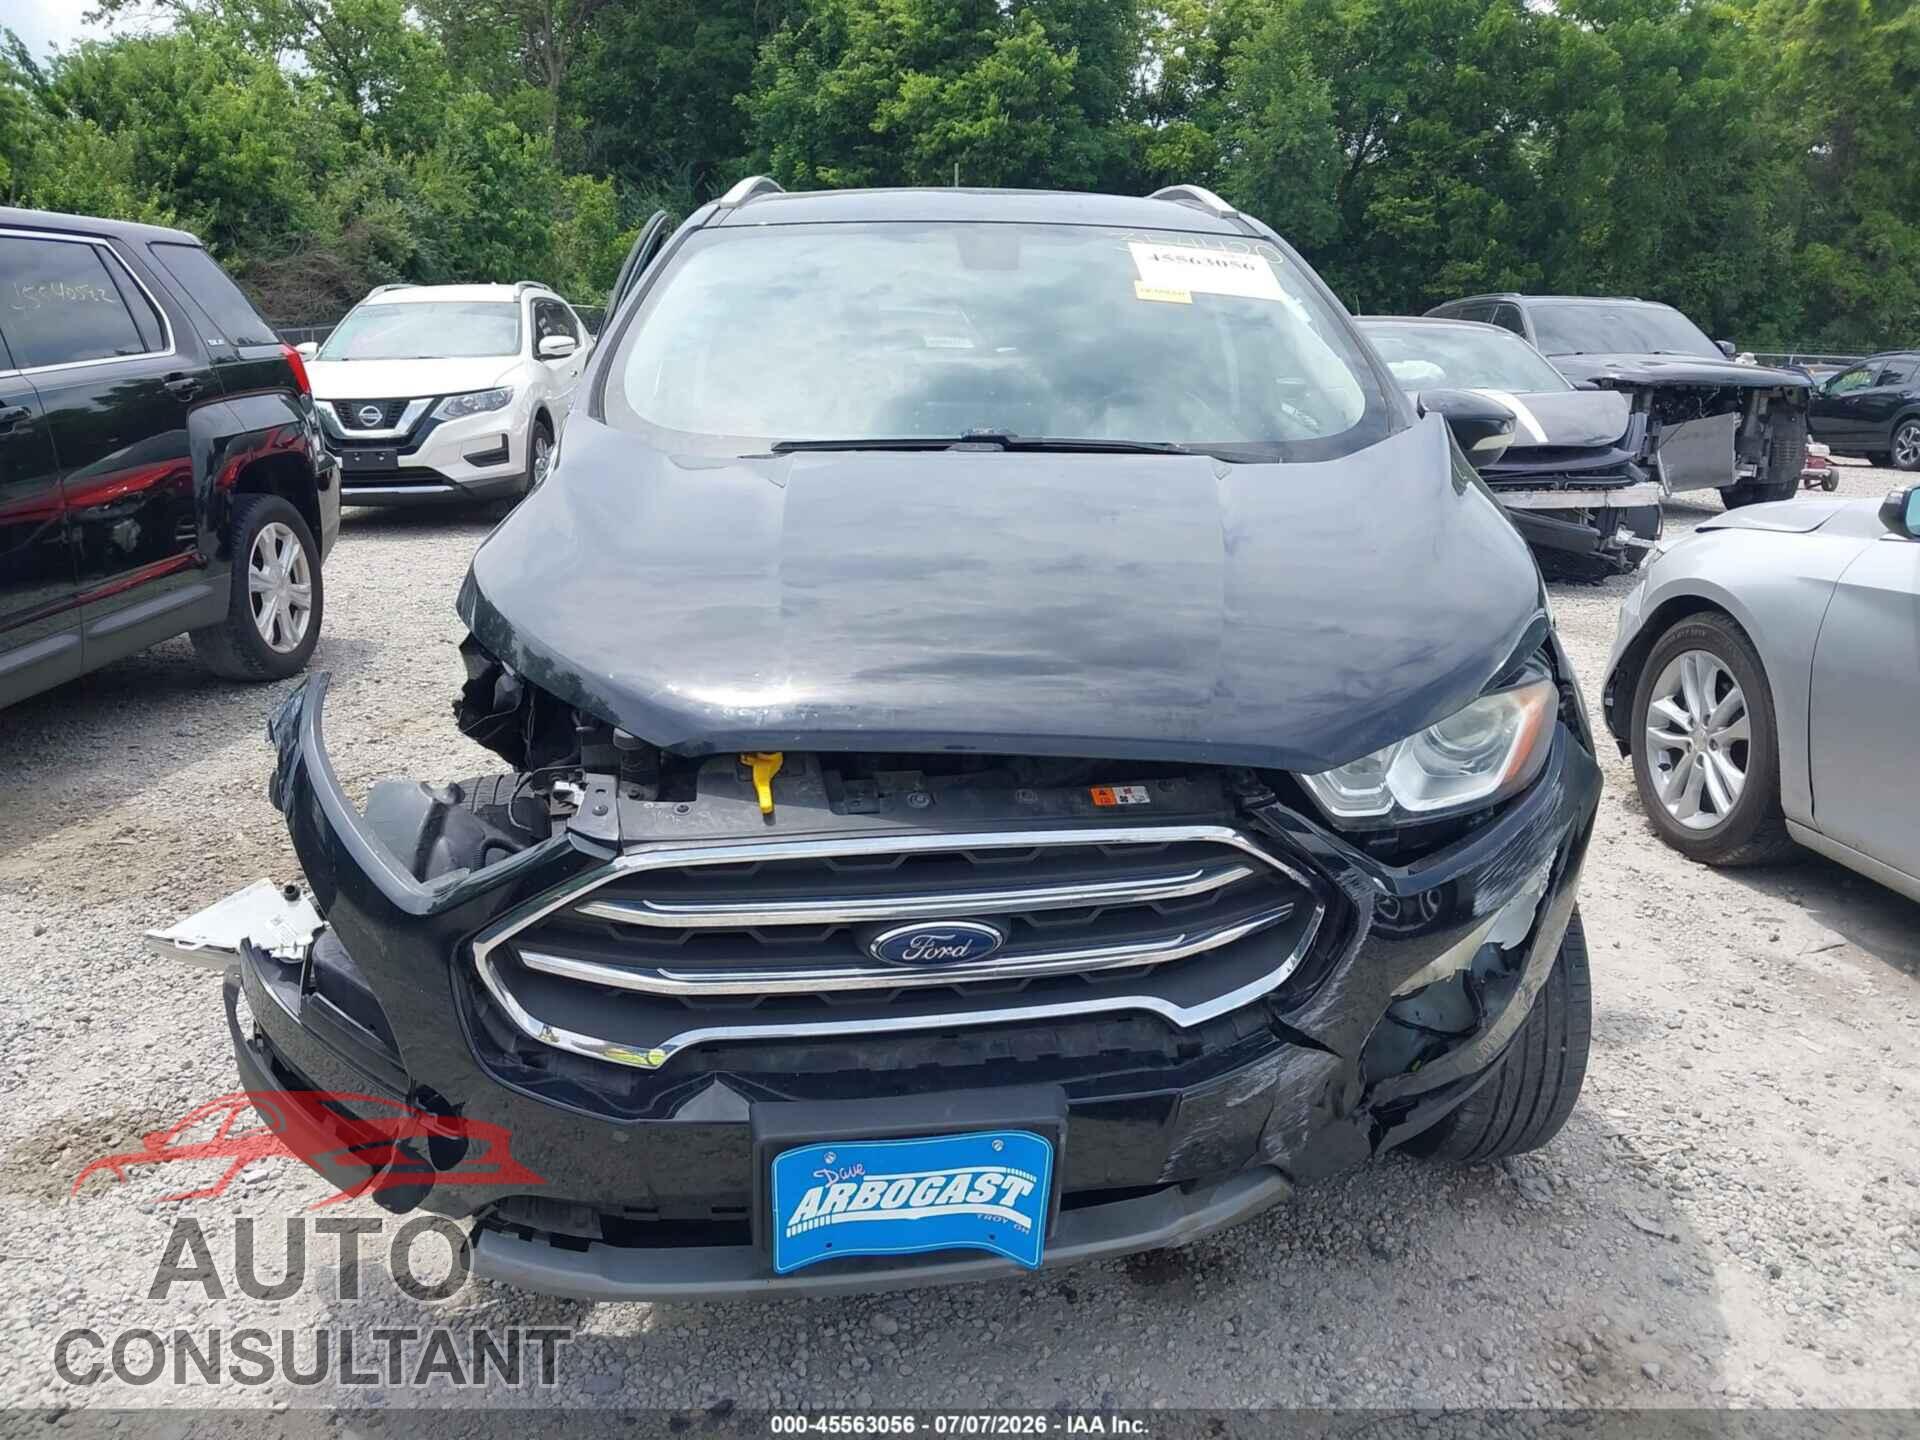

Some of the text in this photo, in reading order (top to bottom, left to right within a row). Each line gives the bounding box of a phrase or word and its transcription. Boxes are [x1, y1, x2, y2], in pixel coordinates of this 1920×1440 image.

[902, 934, 973, 960] Ford
[813, 1163, 866, 1187] Dave
[787, 1172, 1037, 1227] ARBOGAST
[976, 1213, 1009, 1224] TROY
